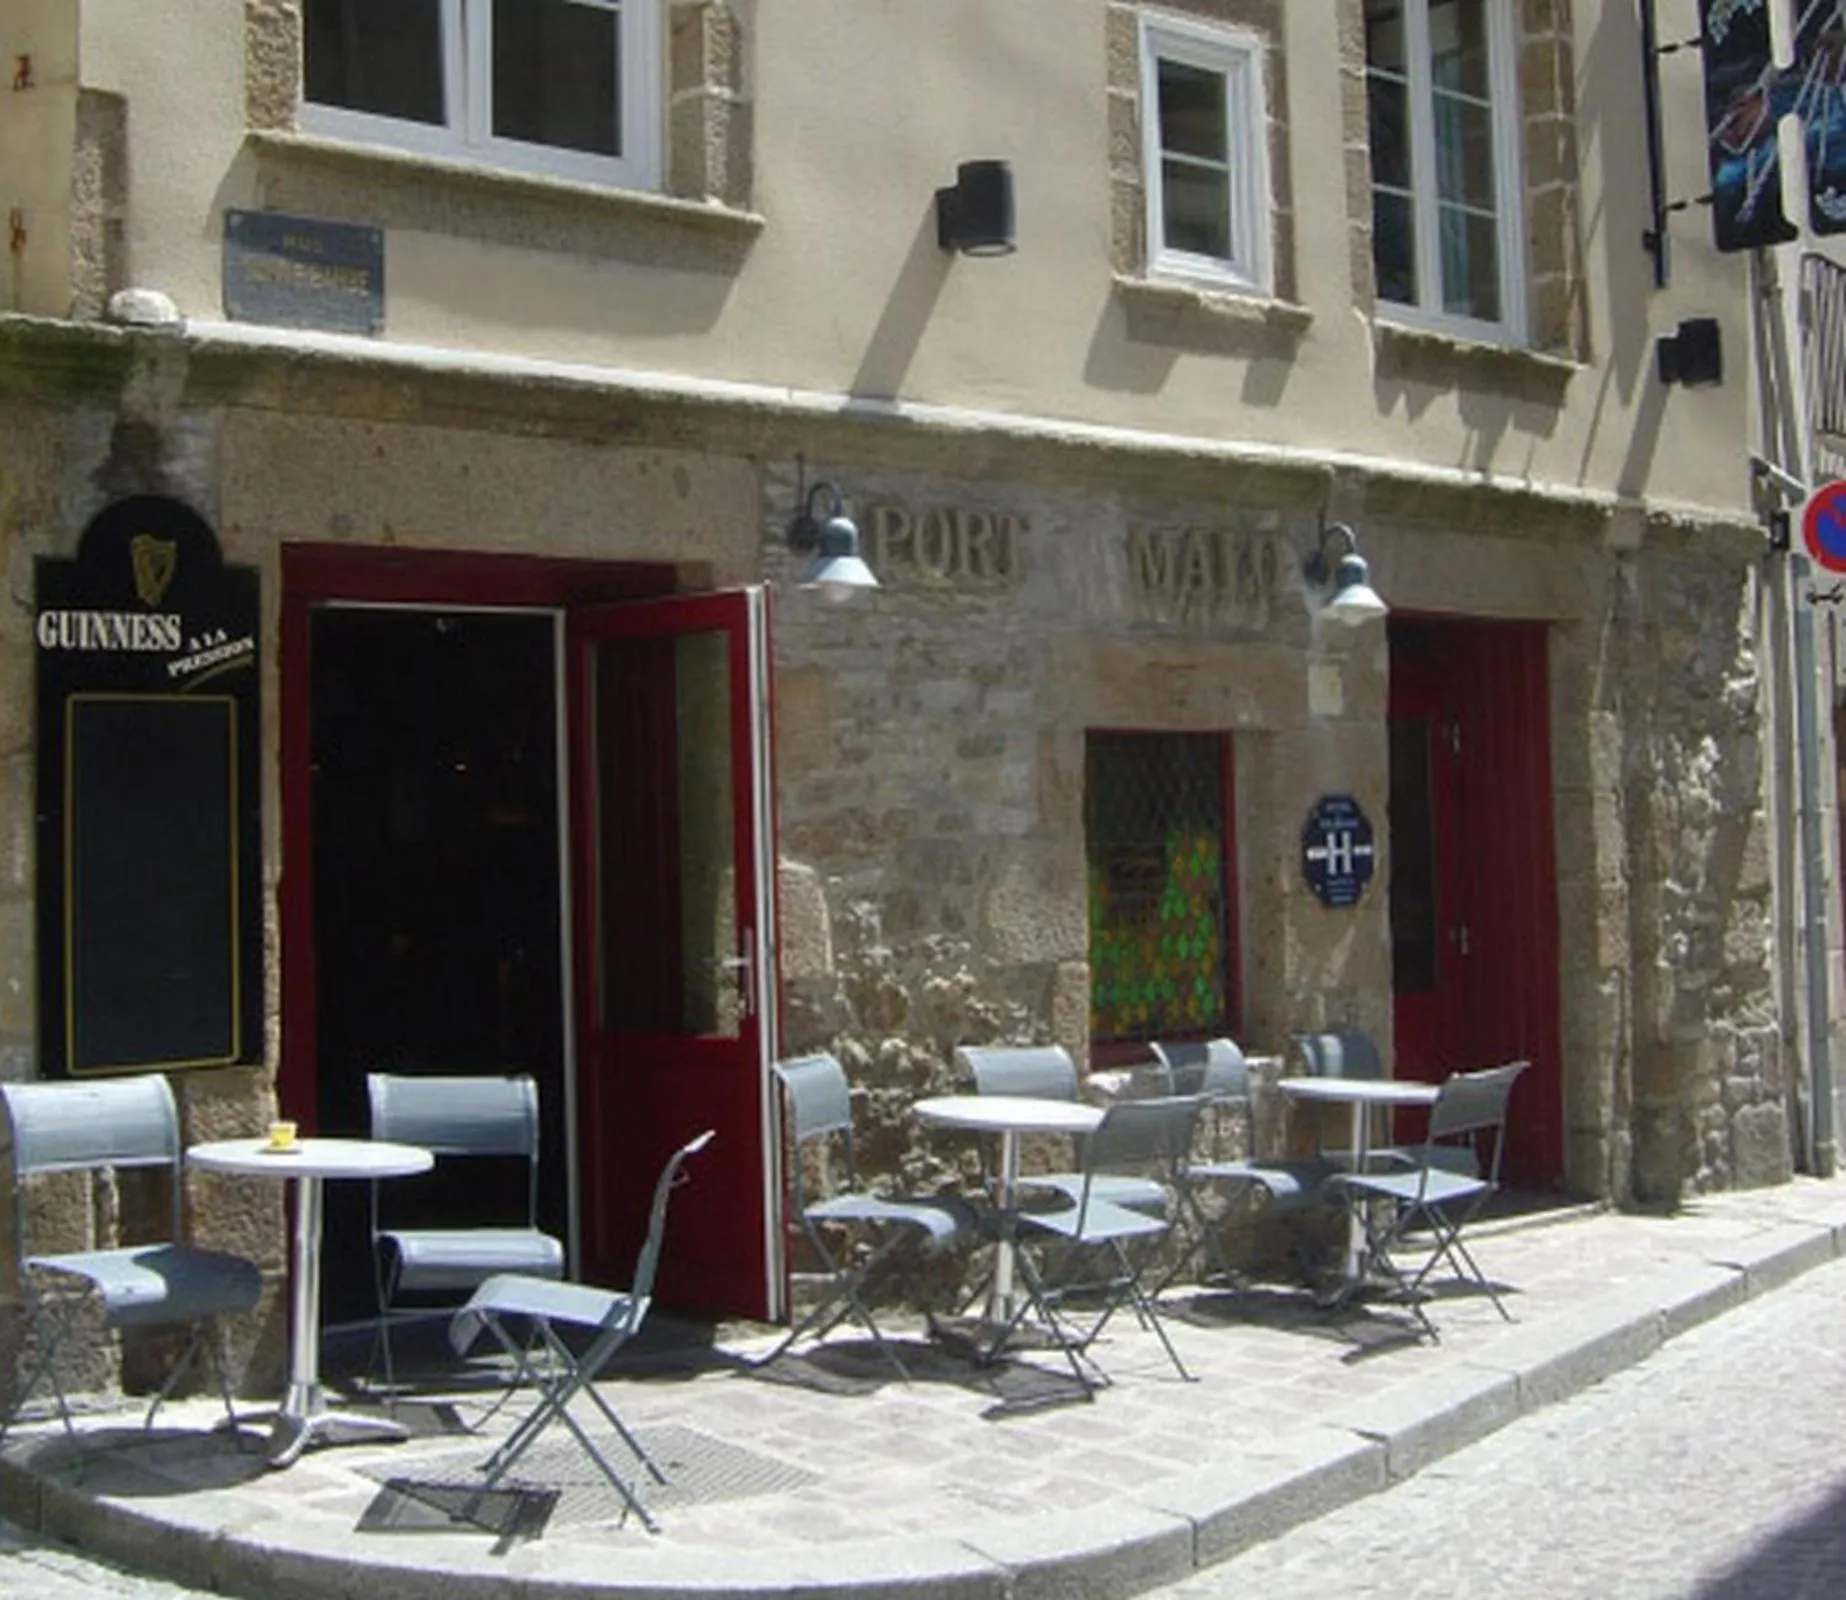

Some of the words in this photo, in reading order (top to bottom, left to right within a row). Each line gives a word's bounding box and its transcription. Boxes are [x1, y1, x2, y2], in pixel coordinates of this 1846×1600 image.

[865, 503, 1031, 580] PORT
[1127, 517, 1282, 598] MALO
[37, 609, 182, 651] GUINNESS
